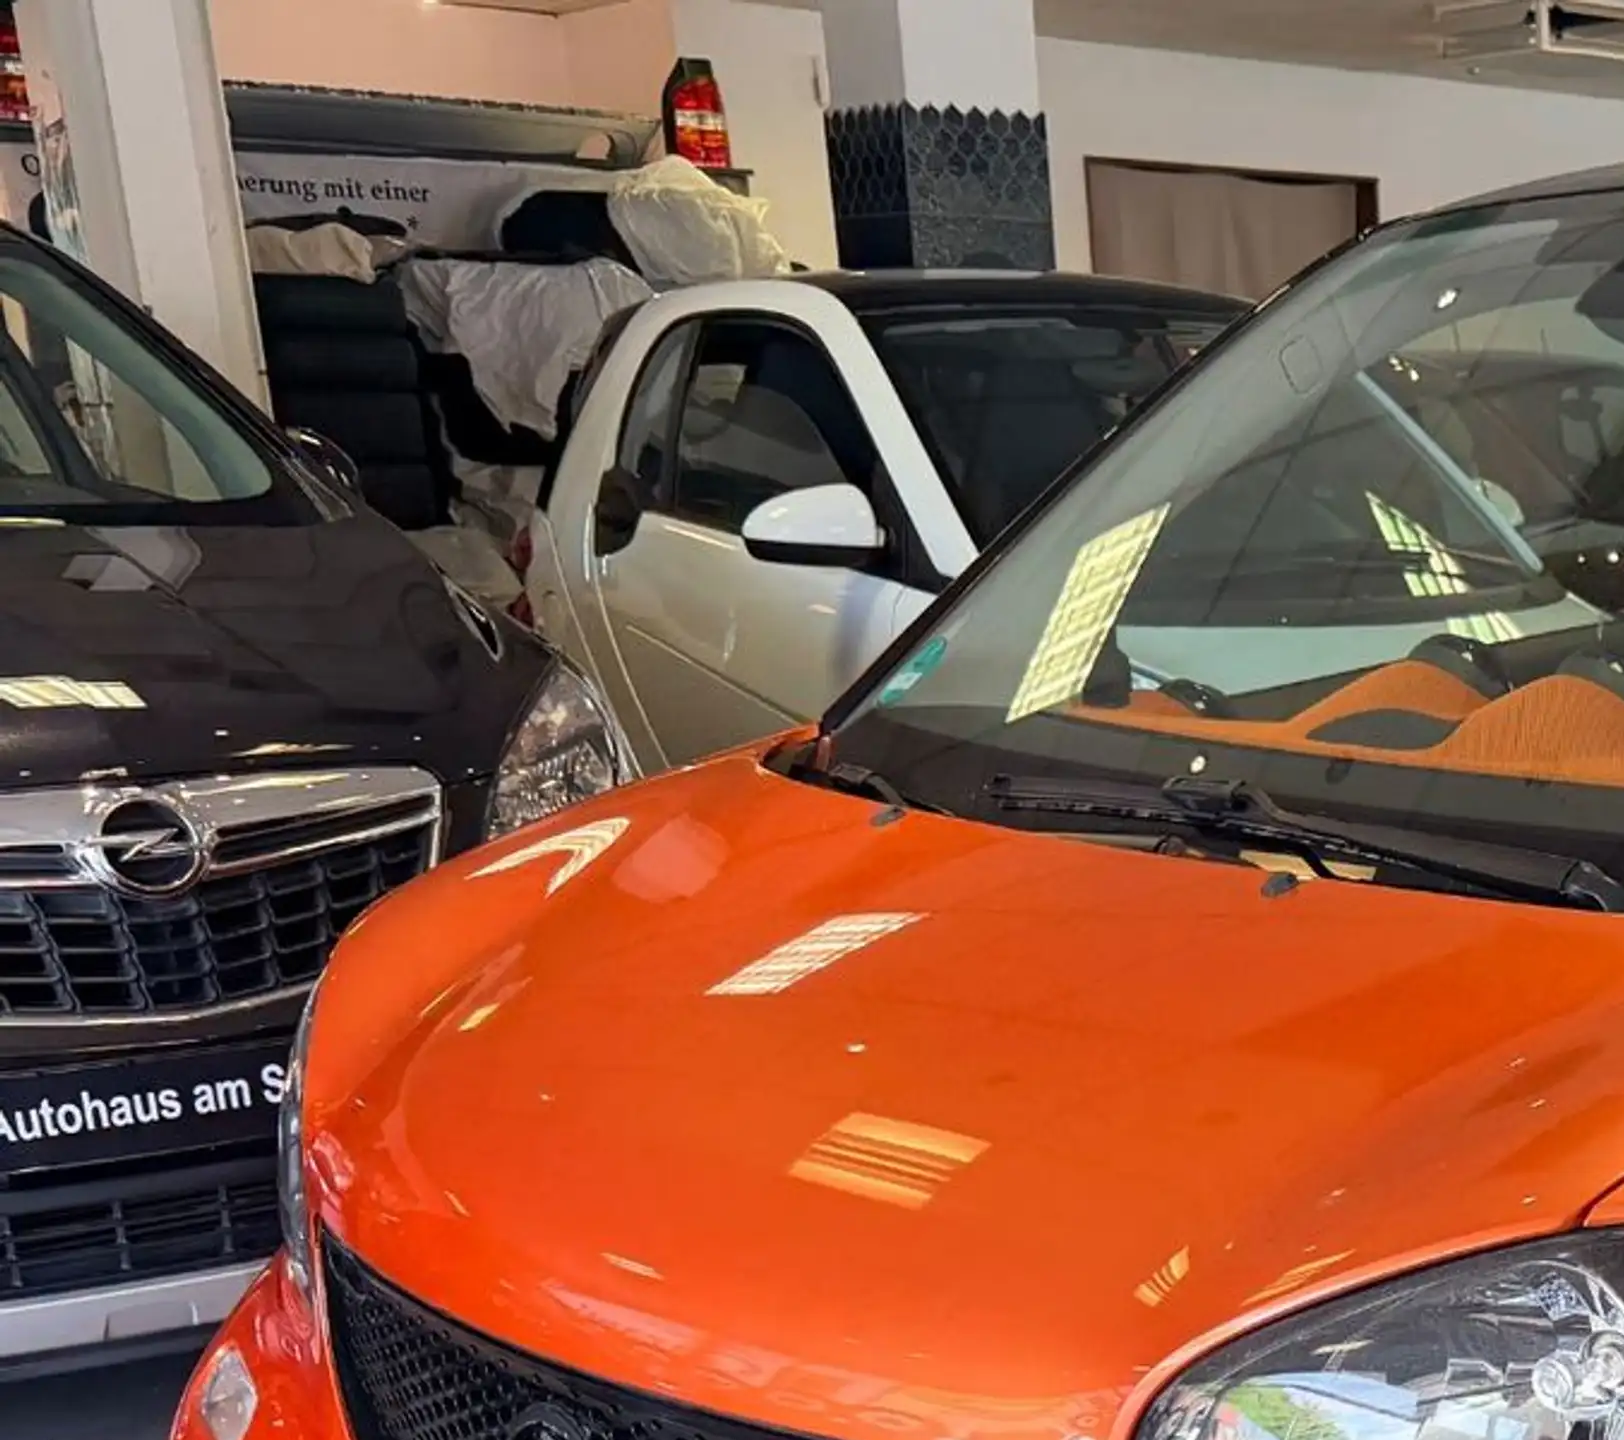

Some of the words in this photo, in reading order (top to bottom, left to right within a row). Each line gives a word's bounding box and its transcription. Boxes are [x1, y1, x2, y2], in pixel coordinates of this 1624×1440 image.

[324, 178, 364, 199] mit
[371, 180, 431, 202] einer
[193, 1077, 251, 1116] am
